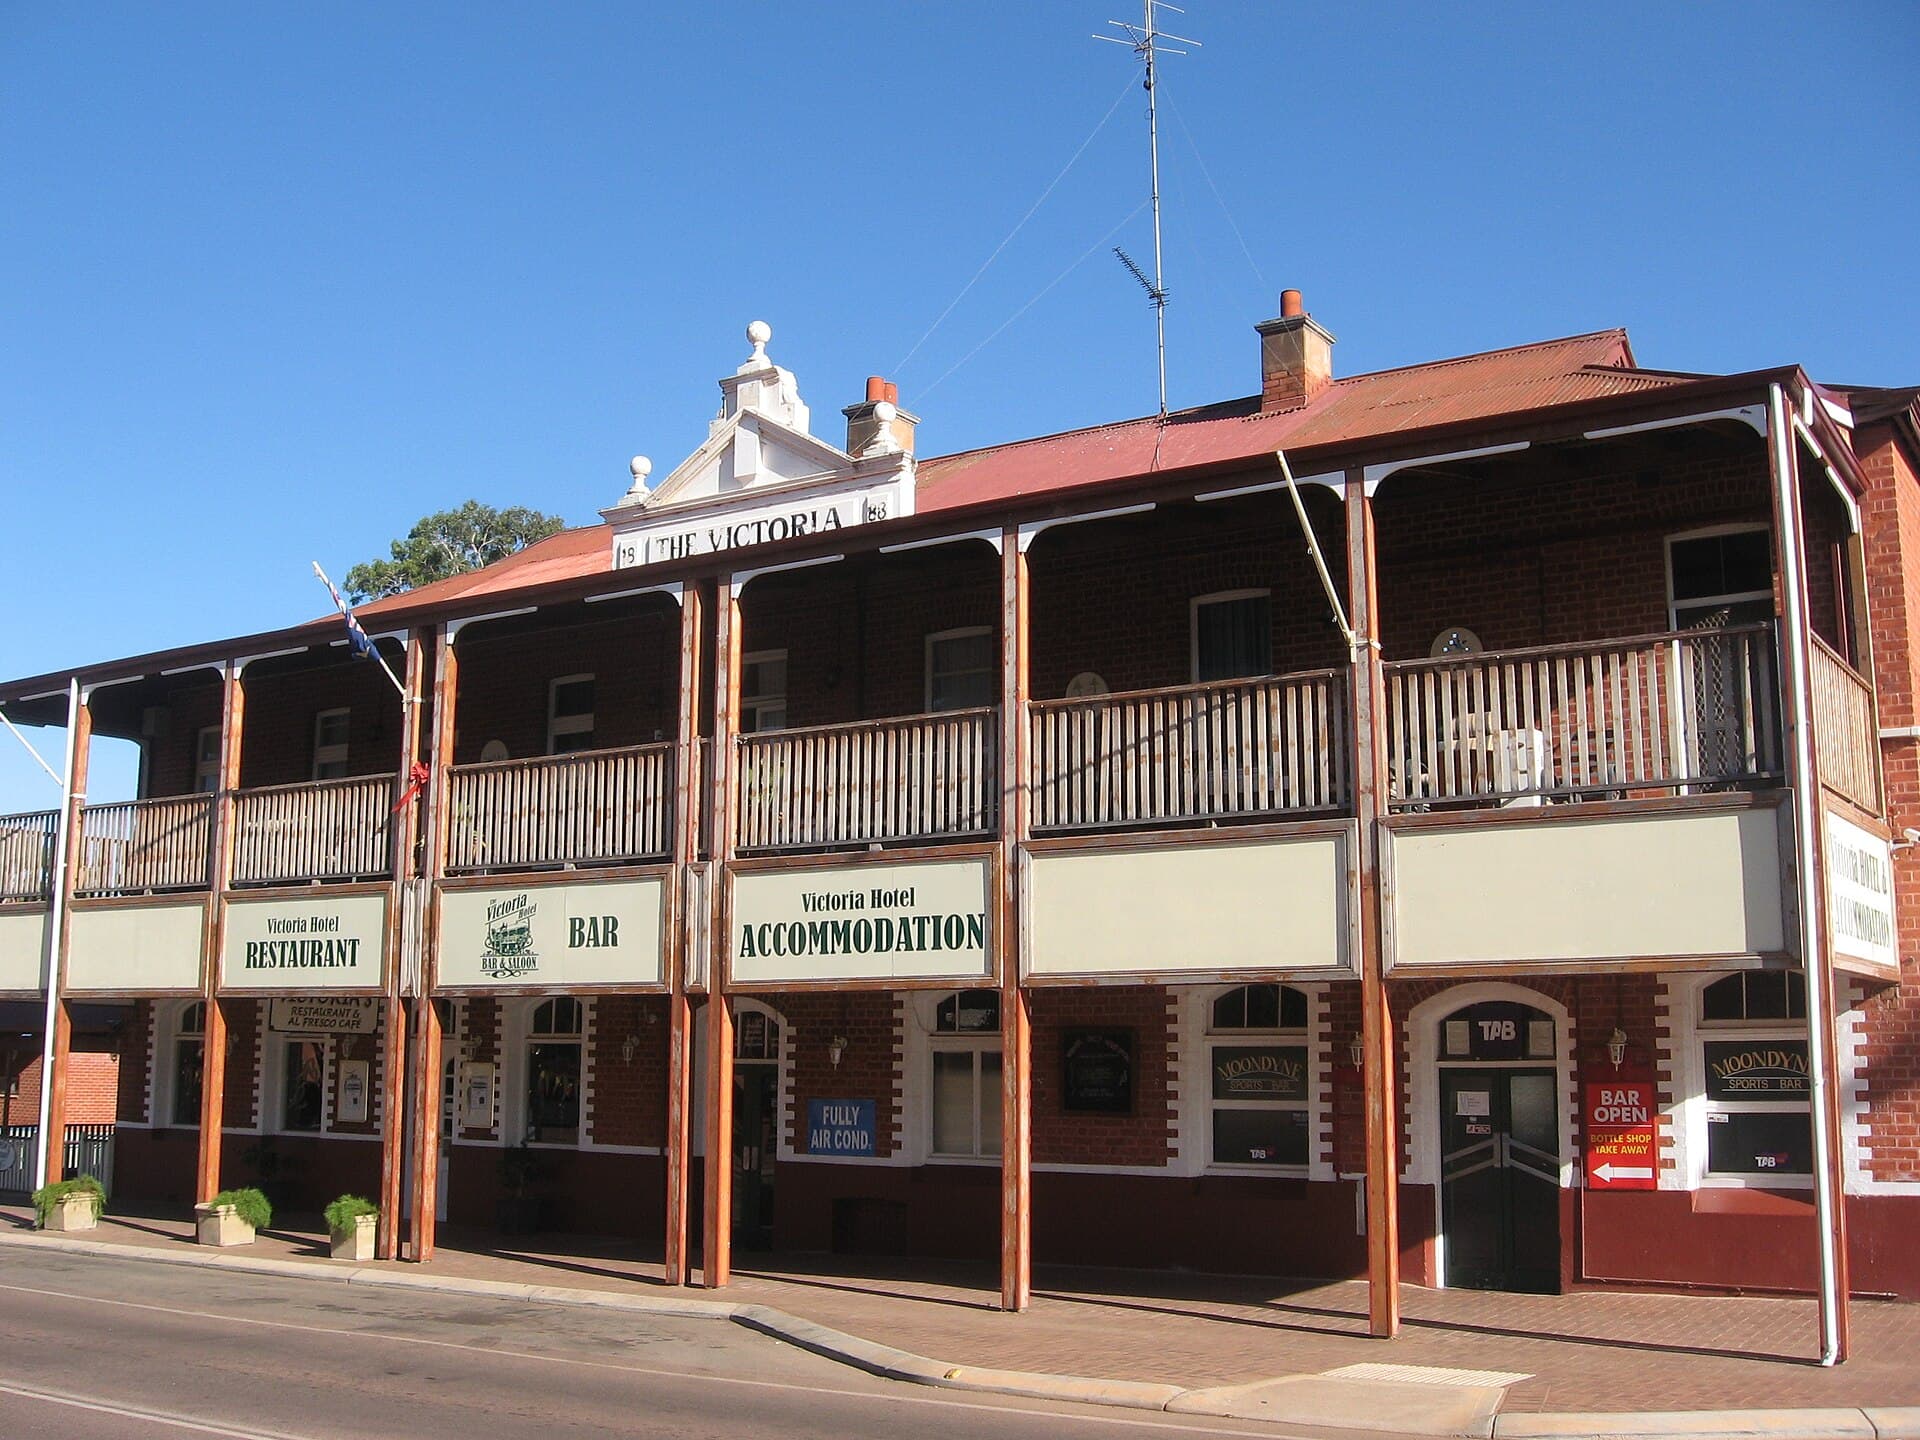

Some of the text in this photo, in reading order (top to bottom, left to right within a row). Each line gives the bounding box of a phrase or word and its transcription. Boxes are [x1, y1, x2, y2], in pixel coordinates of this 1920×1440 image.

[705, 507, 842, 552] VICTORIA
[1830, 832, 1858, 882] Victoria
[1859, 848, 1881, 894] HOTEL
[487, 894, 538, 921] Victoria Hotel
[802, 887, 915, 913] Victoria Hotel
[267, 916, 339, 934] Victoria Hotel
[1835, 892, 1891, 949] ACCOMMODATION
[568, 915, 619, 949] BAR
[739, 913, 986, 958] ACCOMMODATION
[245, 938, 361, 969] RESTAURANT
[482, 956, 537, 970] BAR & SALOON
[291, 1006, 350, 1018] RESTAURANT
[288, 1017, 299, 1026] AL
[302, 1018, 336, 1028] FRESCO
[1478, 1020, 1516, 1041] TAB
[1217, 1055, 1303, 1080] MOONDYNE
[1712, 1050, 1809, 1079] MOONDYN
[1230, 1080, 1264, 1090] SPORTS
[1728, 1079, 1802, 1089] SPORTS BAR
[1600, 1090, 1640, 1106] BAR
[823, 1105, 860, 1126] FULLY
[1593, 1106, 1648, 1122] OPEN
[811, 1129, 831, 1149] AIR
[1591, 1134, 1652, 1143] BOTTLE SHOP
[1249, 1149, 1266, 1159] TAB
[1595, 1145, 1648, 1155] TAKE AWAY
[1755, 1156, 1776, 1167] TAB
